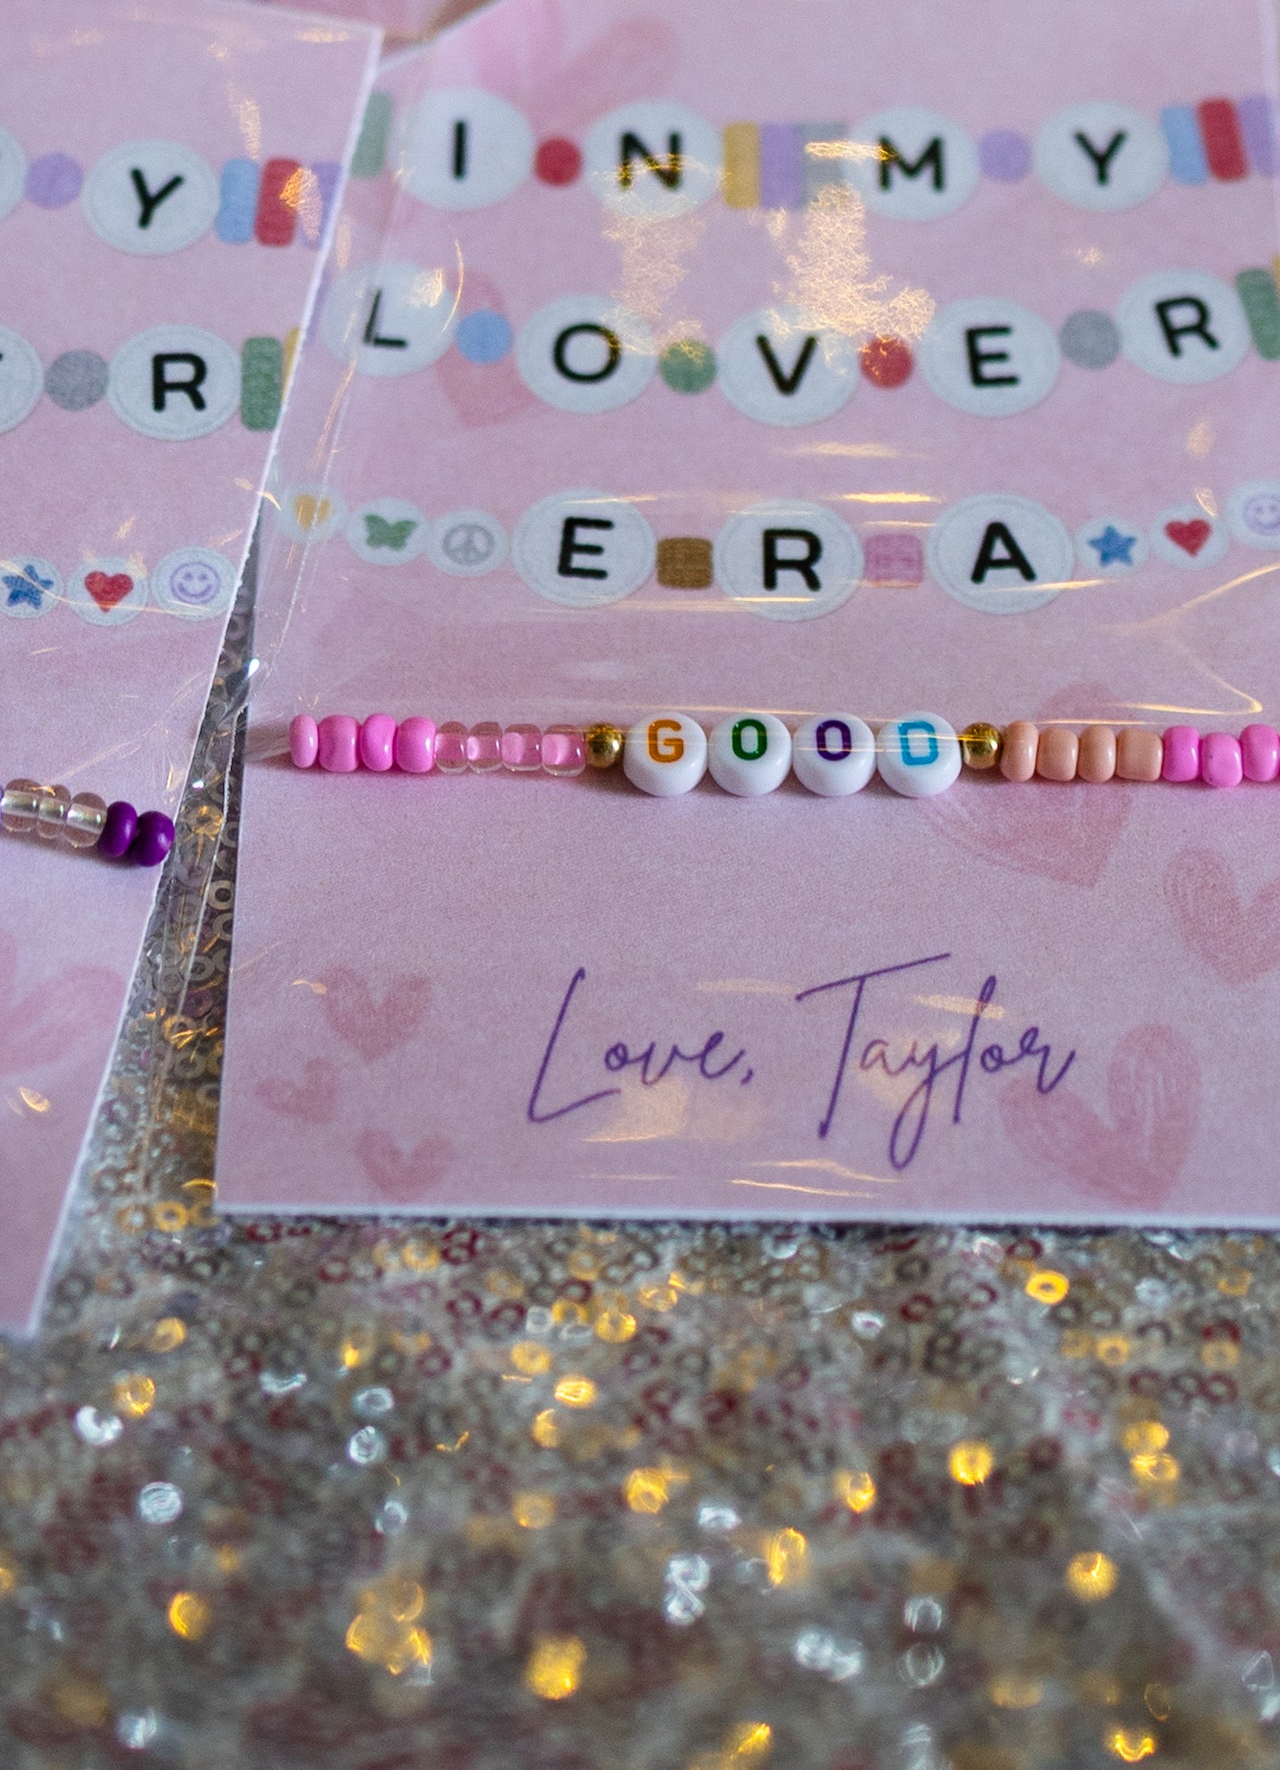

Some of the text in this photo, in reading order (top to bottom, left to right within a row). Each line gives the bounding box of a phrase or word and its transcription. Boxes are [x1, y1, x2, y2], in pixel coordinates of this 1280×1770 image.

[451, 118, 1128, 195] IN MY
[362, 287, 1221, 399] LOVER
[558, 515, 1038, 594] ERA
[645, 716, 941, 767] GOOD
[528, 952, 1075, 1171] Love, Taylor
